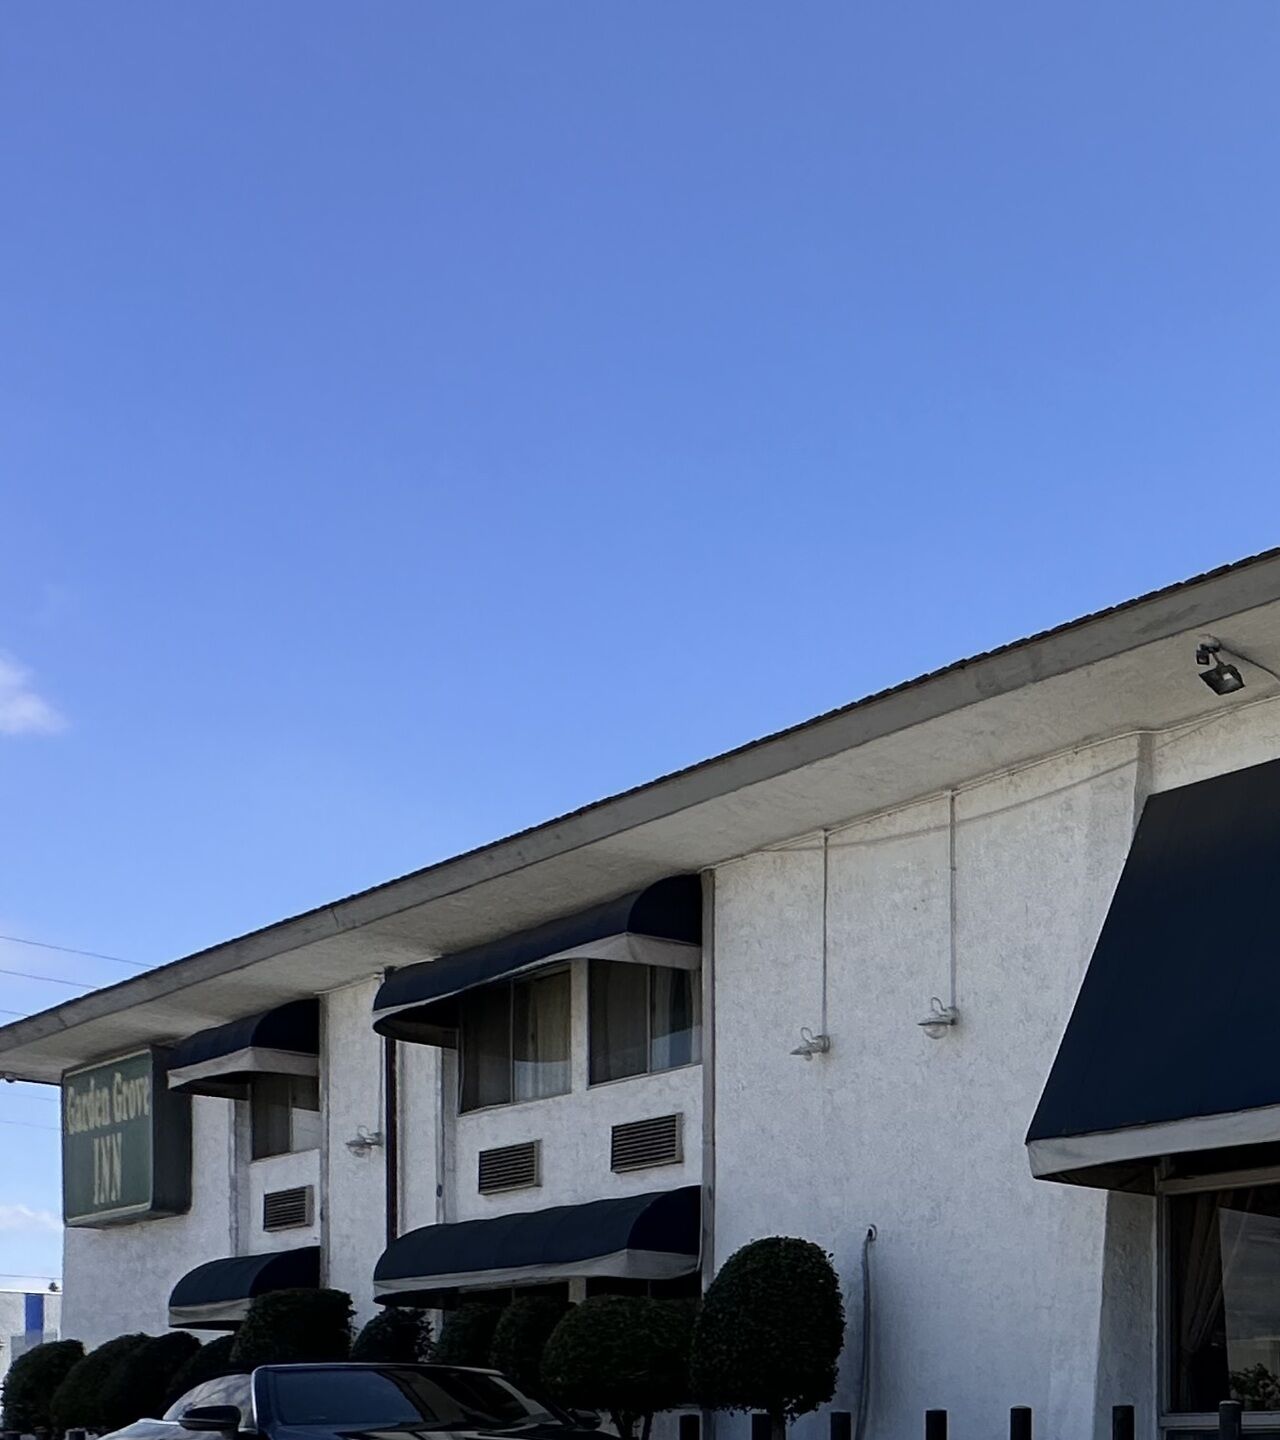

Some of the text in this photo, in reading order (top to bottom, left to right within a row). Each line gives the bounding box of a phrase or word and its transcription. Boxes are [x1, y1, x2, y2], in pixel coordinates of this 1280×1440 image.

[67, 1072, 149, 1135] Garden Grove
[94, 1132, 122, 1205] INN
